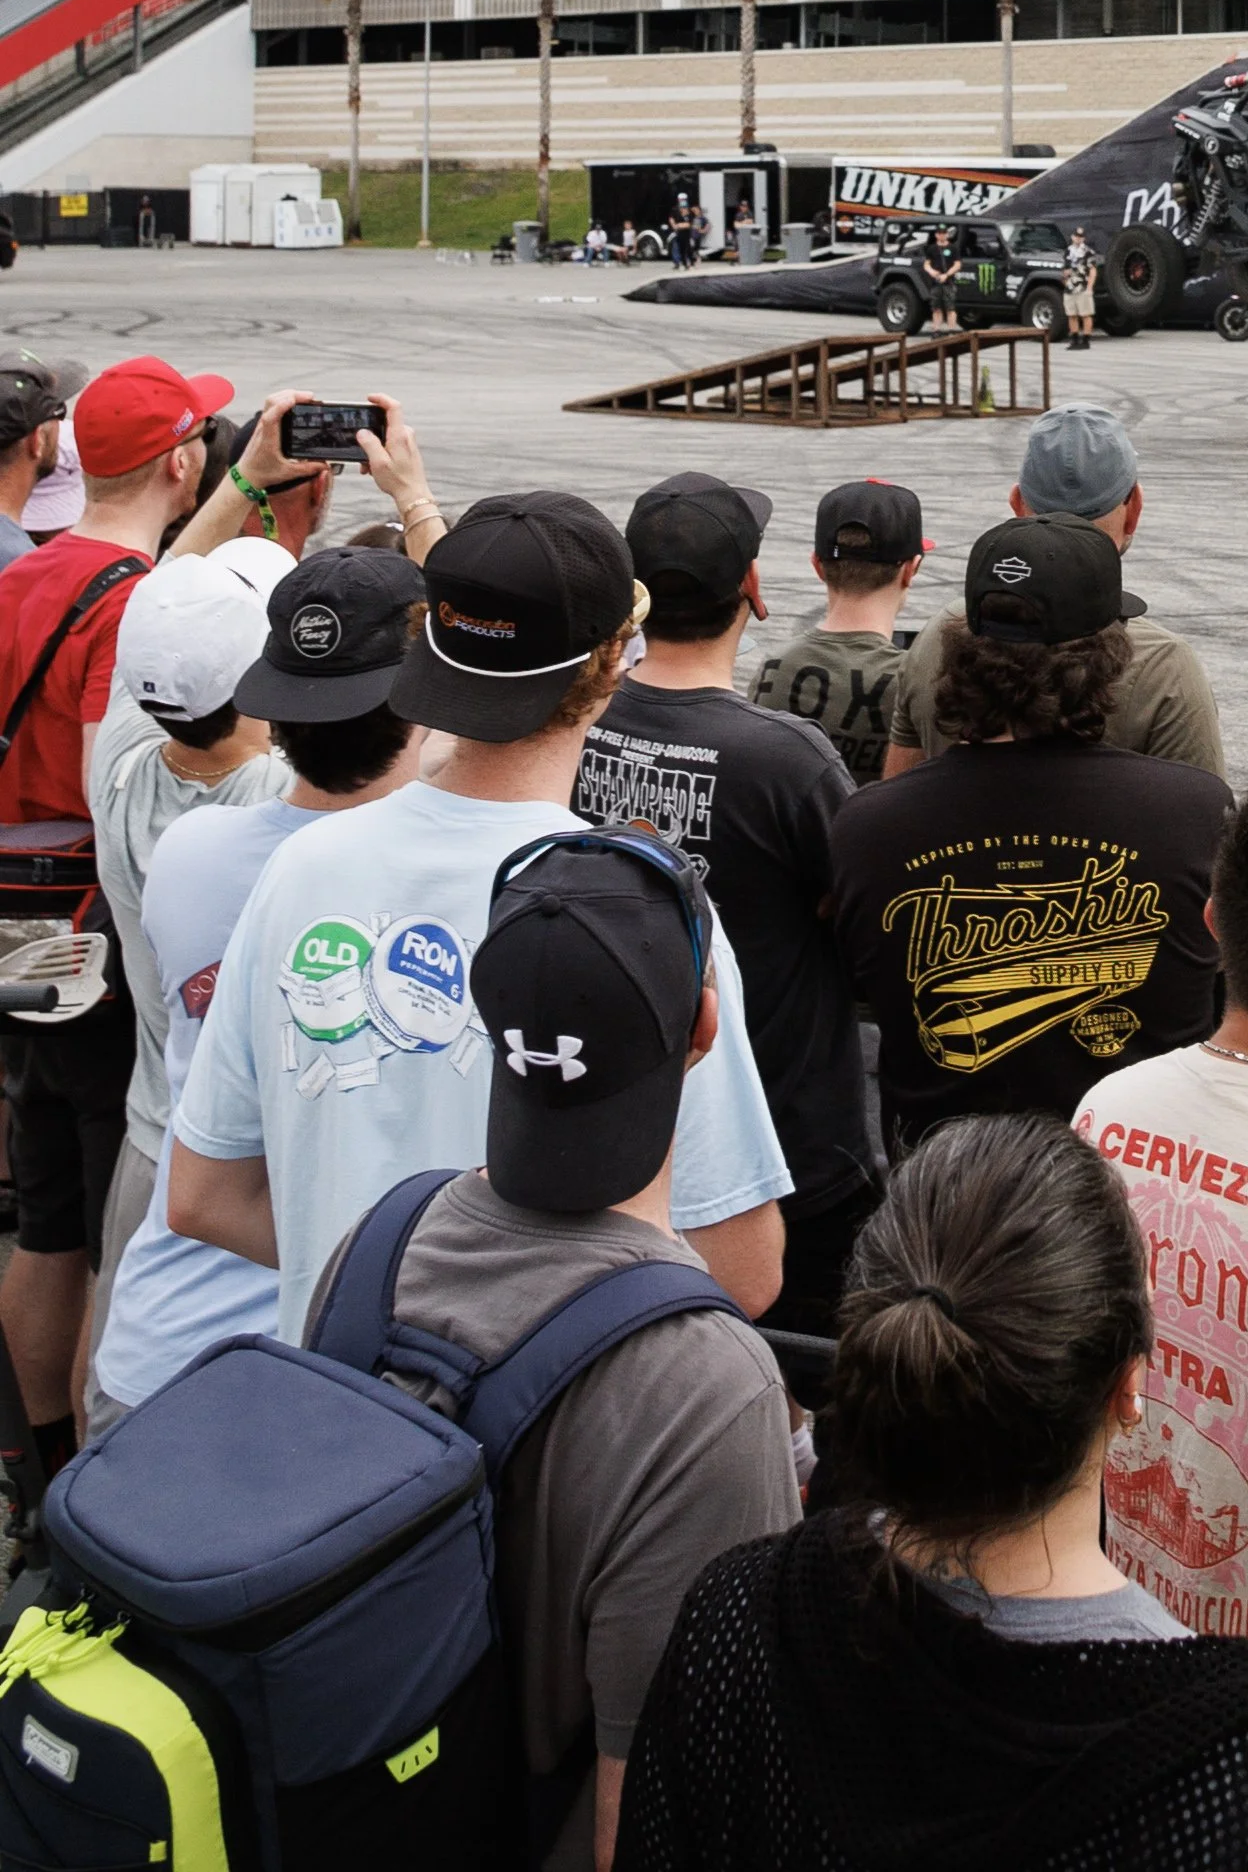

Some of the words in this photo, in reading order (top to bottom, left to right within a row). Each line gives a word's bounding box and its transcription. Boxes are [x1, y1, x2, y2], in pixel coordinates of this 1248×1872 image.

[455, 620, 516, 639] PRODUCTS
[751, 659, 896, 733] FOX
[905, 840, 974, 871] INSPIRED
[983, 837, 1001, 848] BY
[1013, 835, 1040, 846] THE
[1050, 835, 1090, 848] OPEN
[1100, 841, 1139, 860] ROAD
[882, 857, 1170, 981] Thrashin
[303, 938, 360, 966] OLD
[1030, 963, 1102, 985] SUPPLY
[1080, 1012, 1129, 1027] DESIGNED
